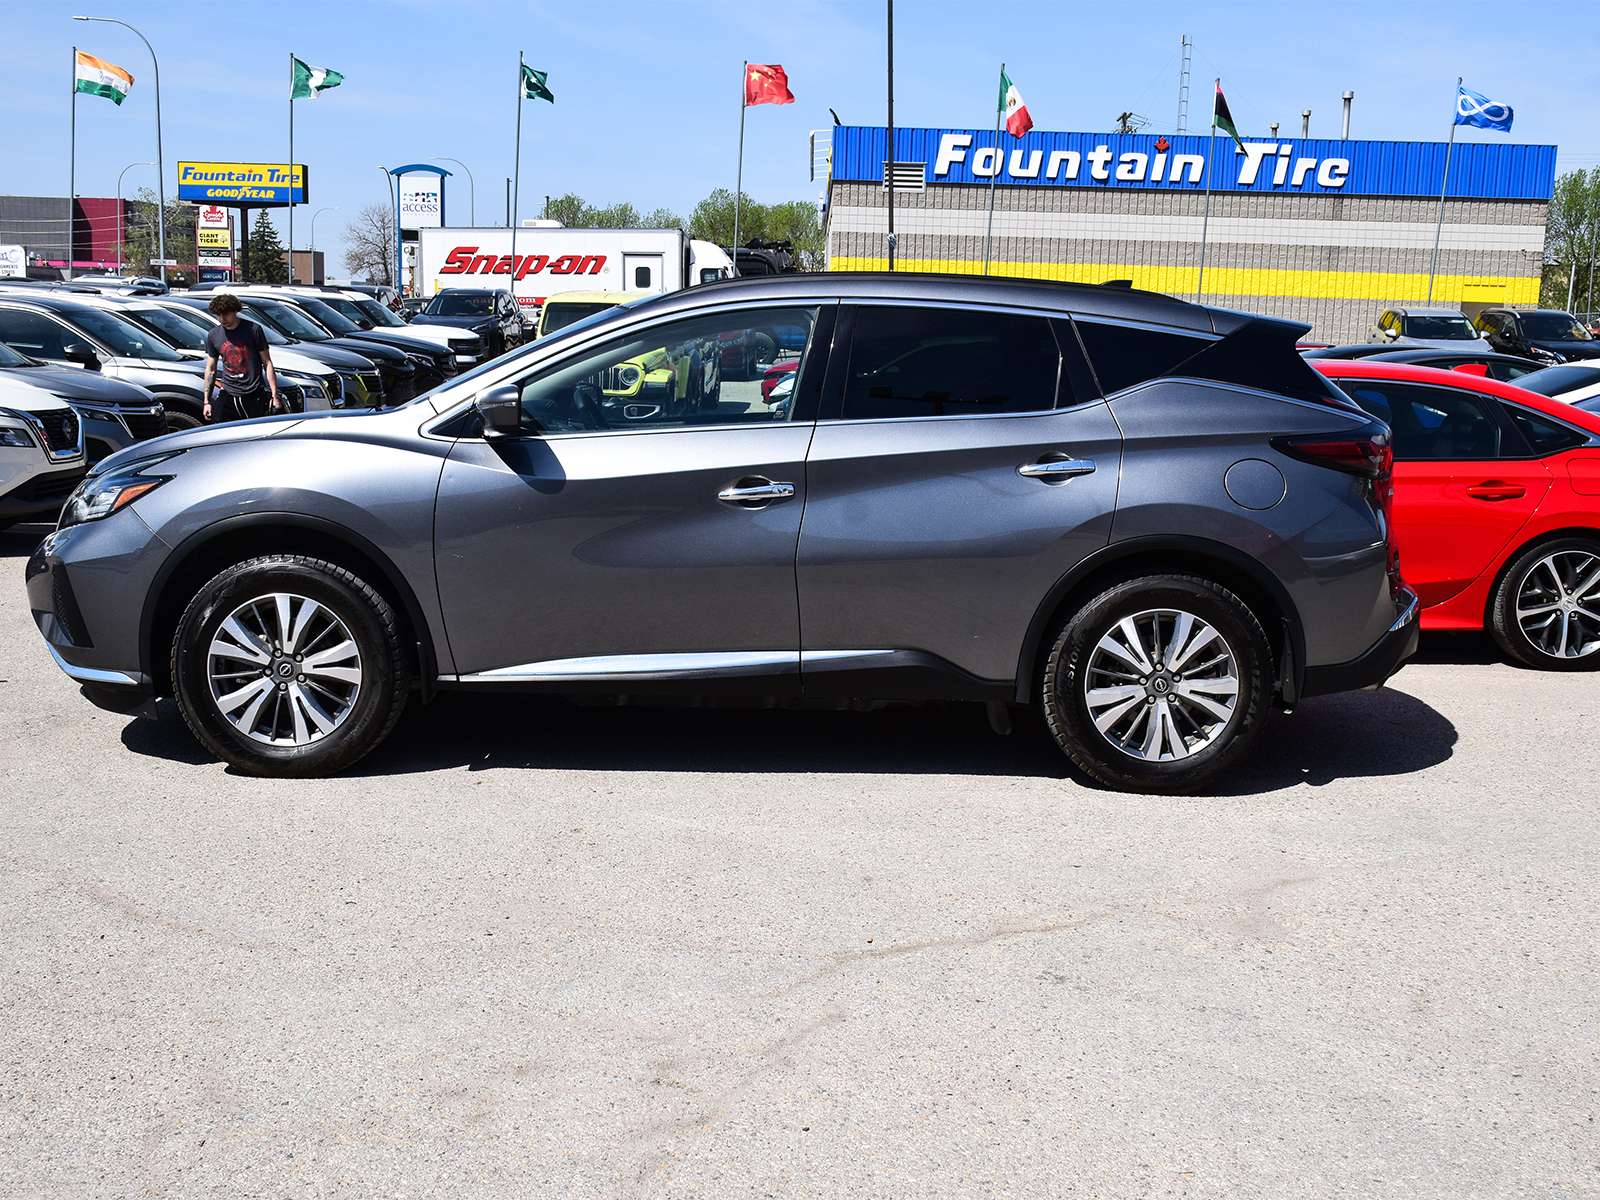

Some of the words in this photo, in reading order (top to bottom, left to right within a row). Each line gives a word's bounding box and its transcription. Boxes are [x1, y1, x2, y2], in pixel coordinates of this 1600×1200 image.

[933, 133, 1204, 183] Fountain
[1235, 142, 1350, 188] Tire
[181, 166, 264, 183] Fountain
[267, 168, 301, 184] Tire
[206, 187, 276, 200] GOODYEAR
[402, 203, 439, 213] access
[439, 246, 607, 281] Snap-on
